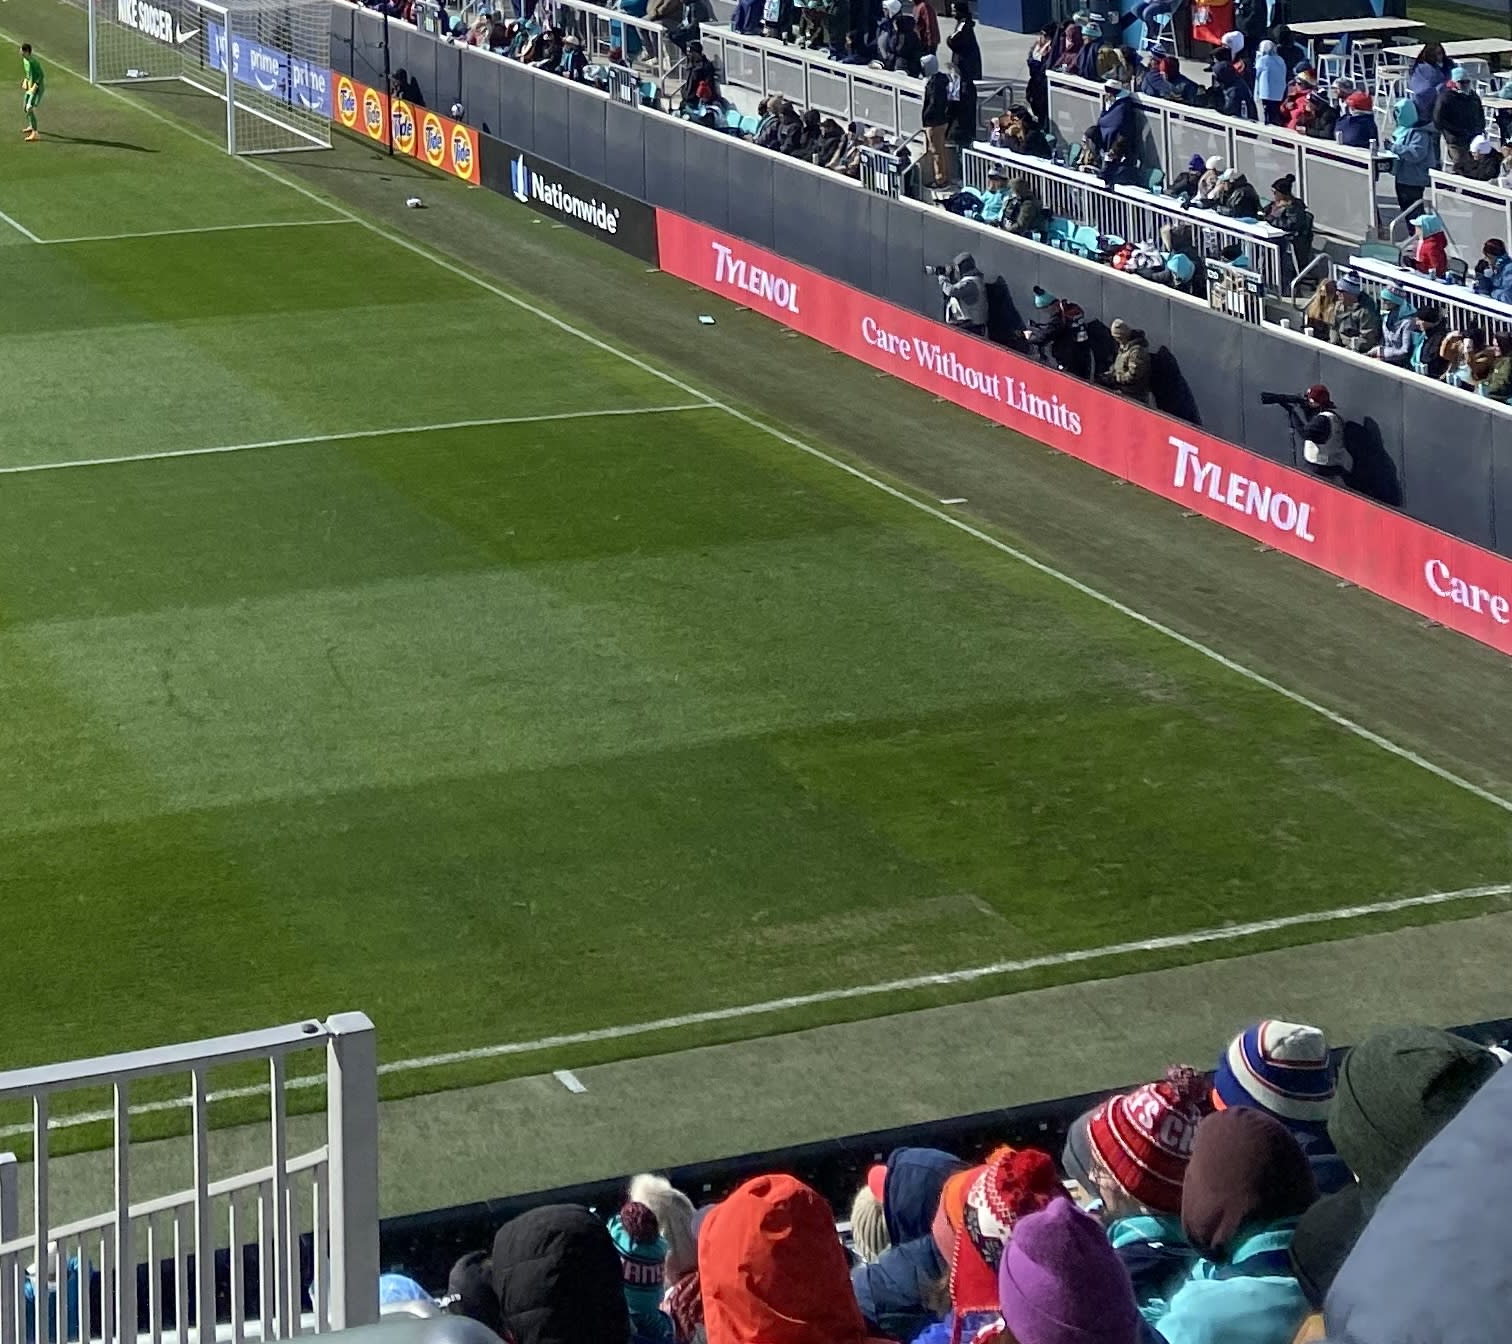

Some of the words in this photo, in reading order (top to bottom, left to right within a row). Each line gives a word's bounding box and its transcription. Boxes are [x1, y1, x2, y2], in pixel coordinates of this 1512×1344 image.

[138, 1, 173, 44] SOCCER
[250, 48, 280, 77] prime
[340, 89, 356, 112] Tide
[365, 102, 380, 125] Tide
[392, 113, 413, 138] Tide
[426, 126, 443, 150] Tide
[454, 138, 471, 163] Tide
[532, 172, 618, 233] Nationwide
[712, 242, 800, 313] TYLENOL
[862, 317, 911, 360] Care
[914, 337, 1000, 401] Without
[1006, 377, 1082, 435] Limits
[1169, 436, 1315, 543] TYLENOL
[1424, 559, 1510, 625] Care
